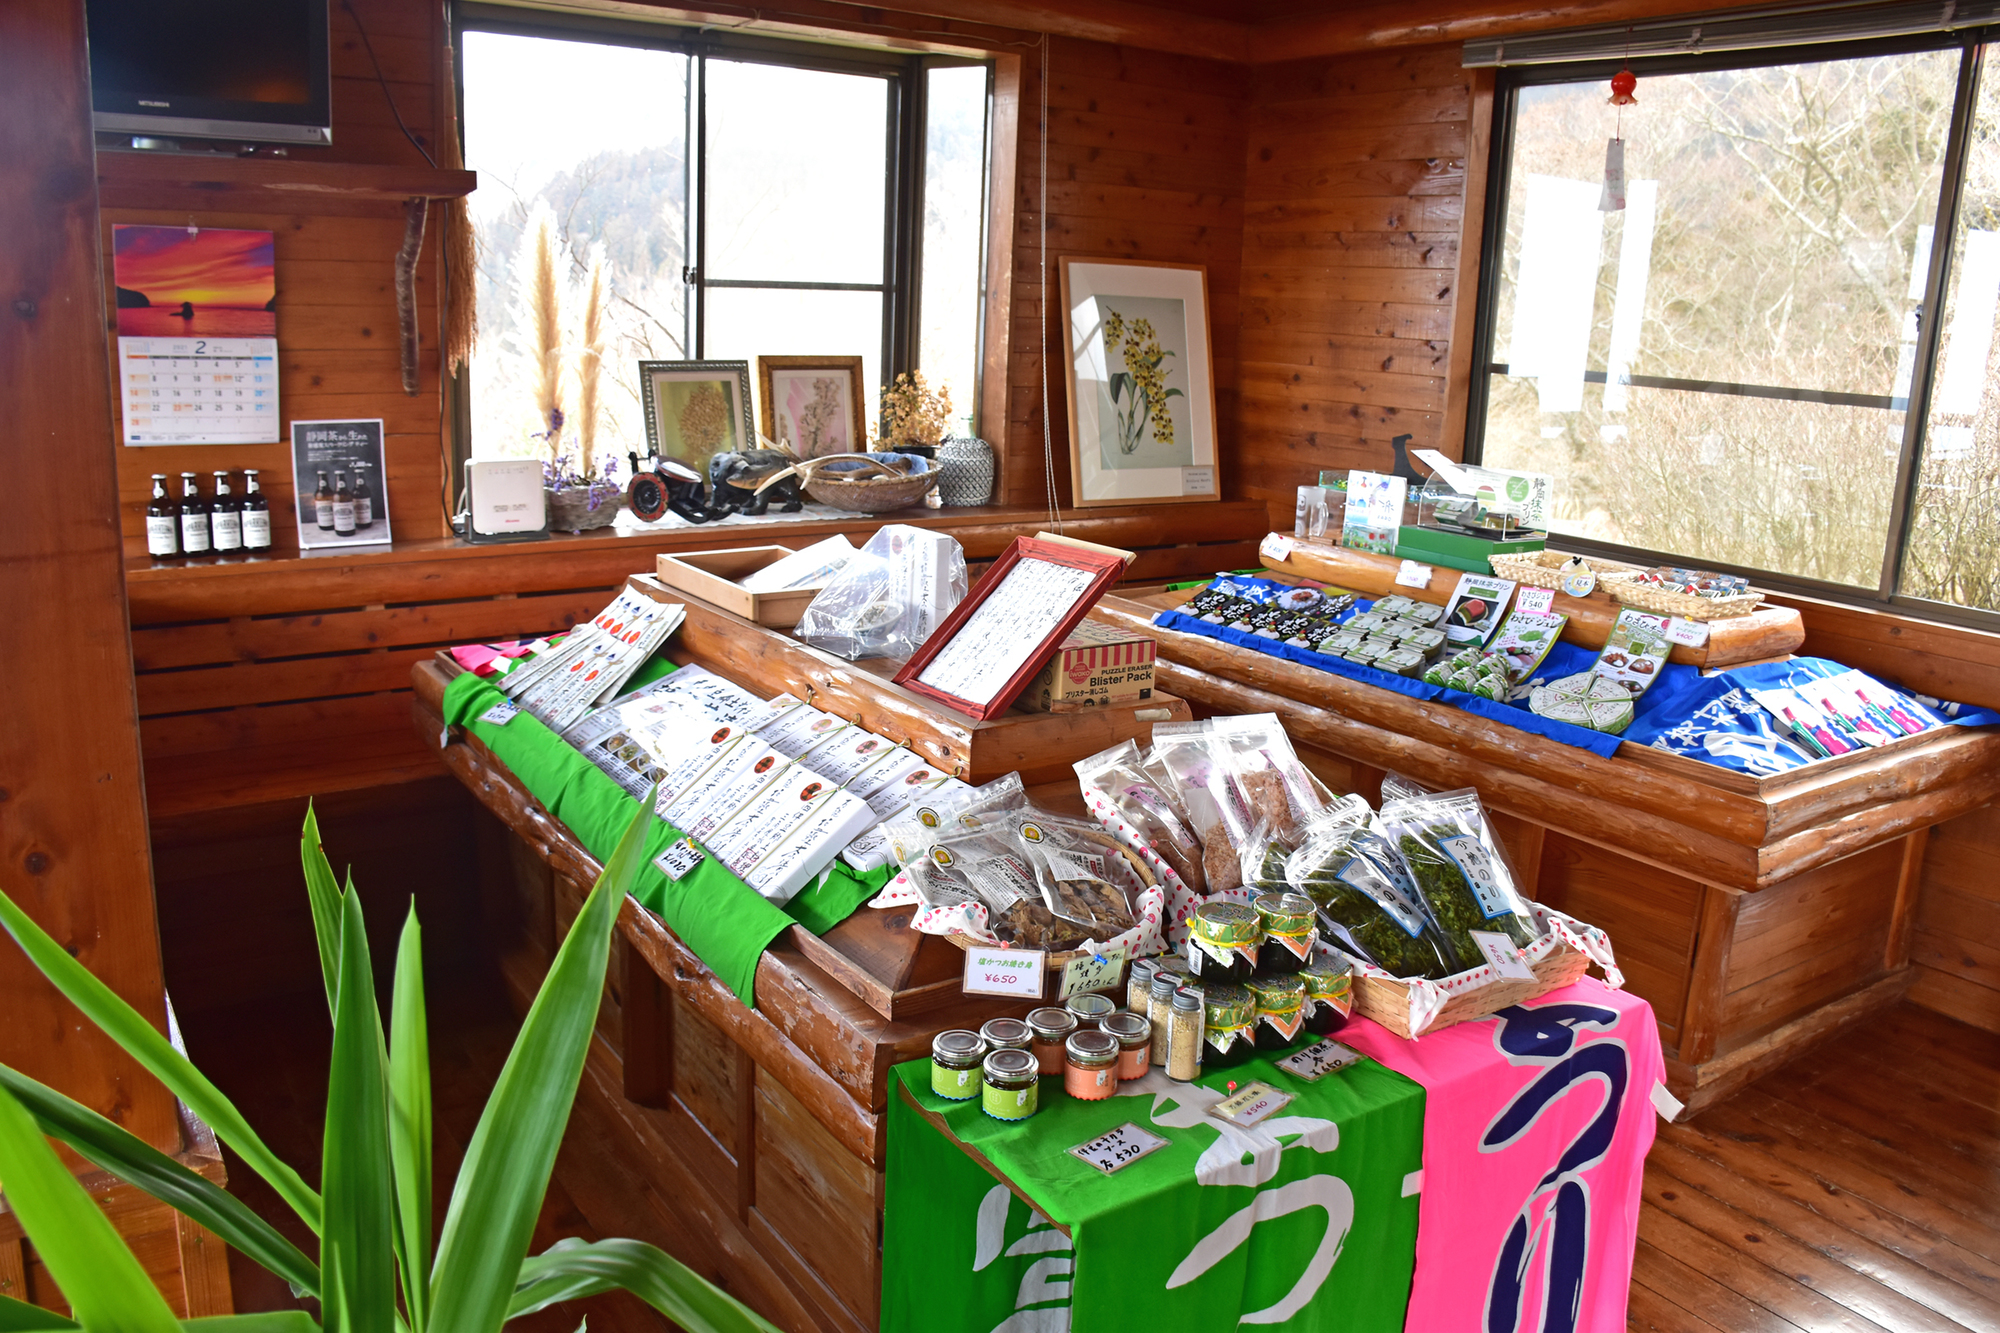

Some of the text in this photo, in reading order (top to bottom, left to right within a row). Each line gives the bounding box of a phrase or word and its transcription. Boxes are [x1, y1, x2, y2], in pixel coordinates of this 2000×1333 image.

[195, 341, 207, 354] 2
[1101, 664, 1153, 676] PUZZLE ERASER
[1089, 671, 1152, 687] Blister Pack
[1065, 686, 1109, 699] ブリスター消しゴム
[984, 972, 1018, 985] ¥650
[1243, 1100, 1268, 1116] ¥540
[1115, 1144, 1141, 1162] 530
